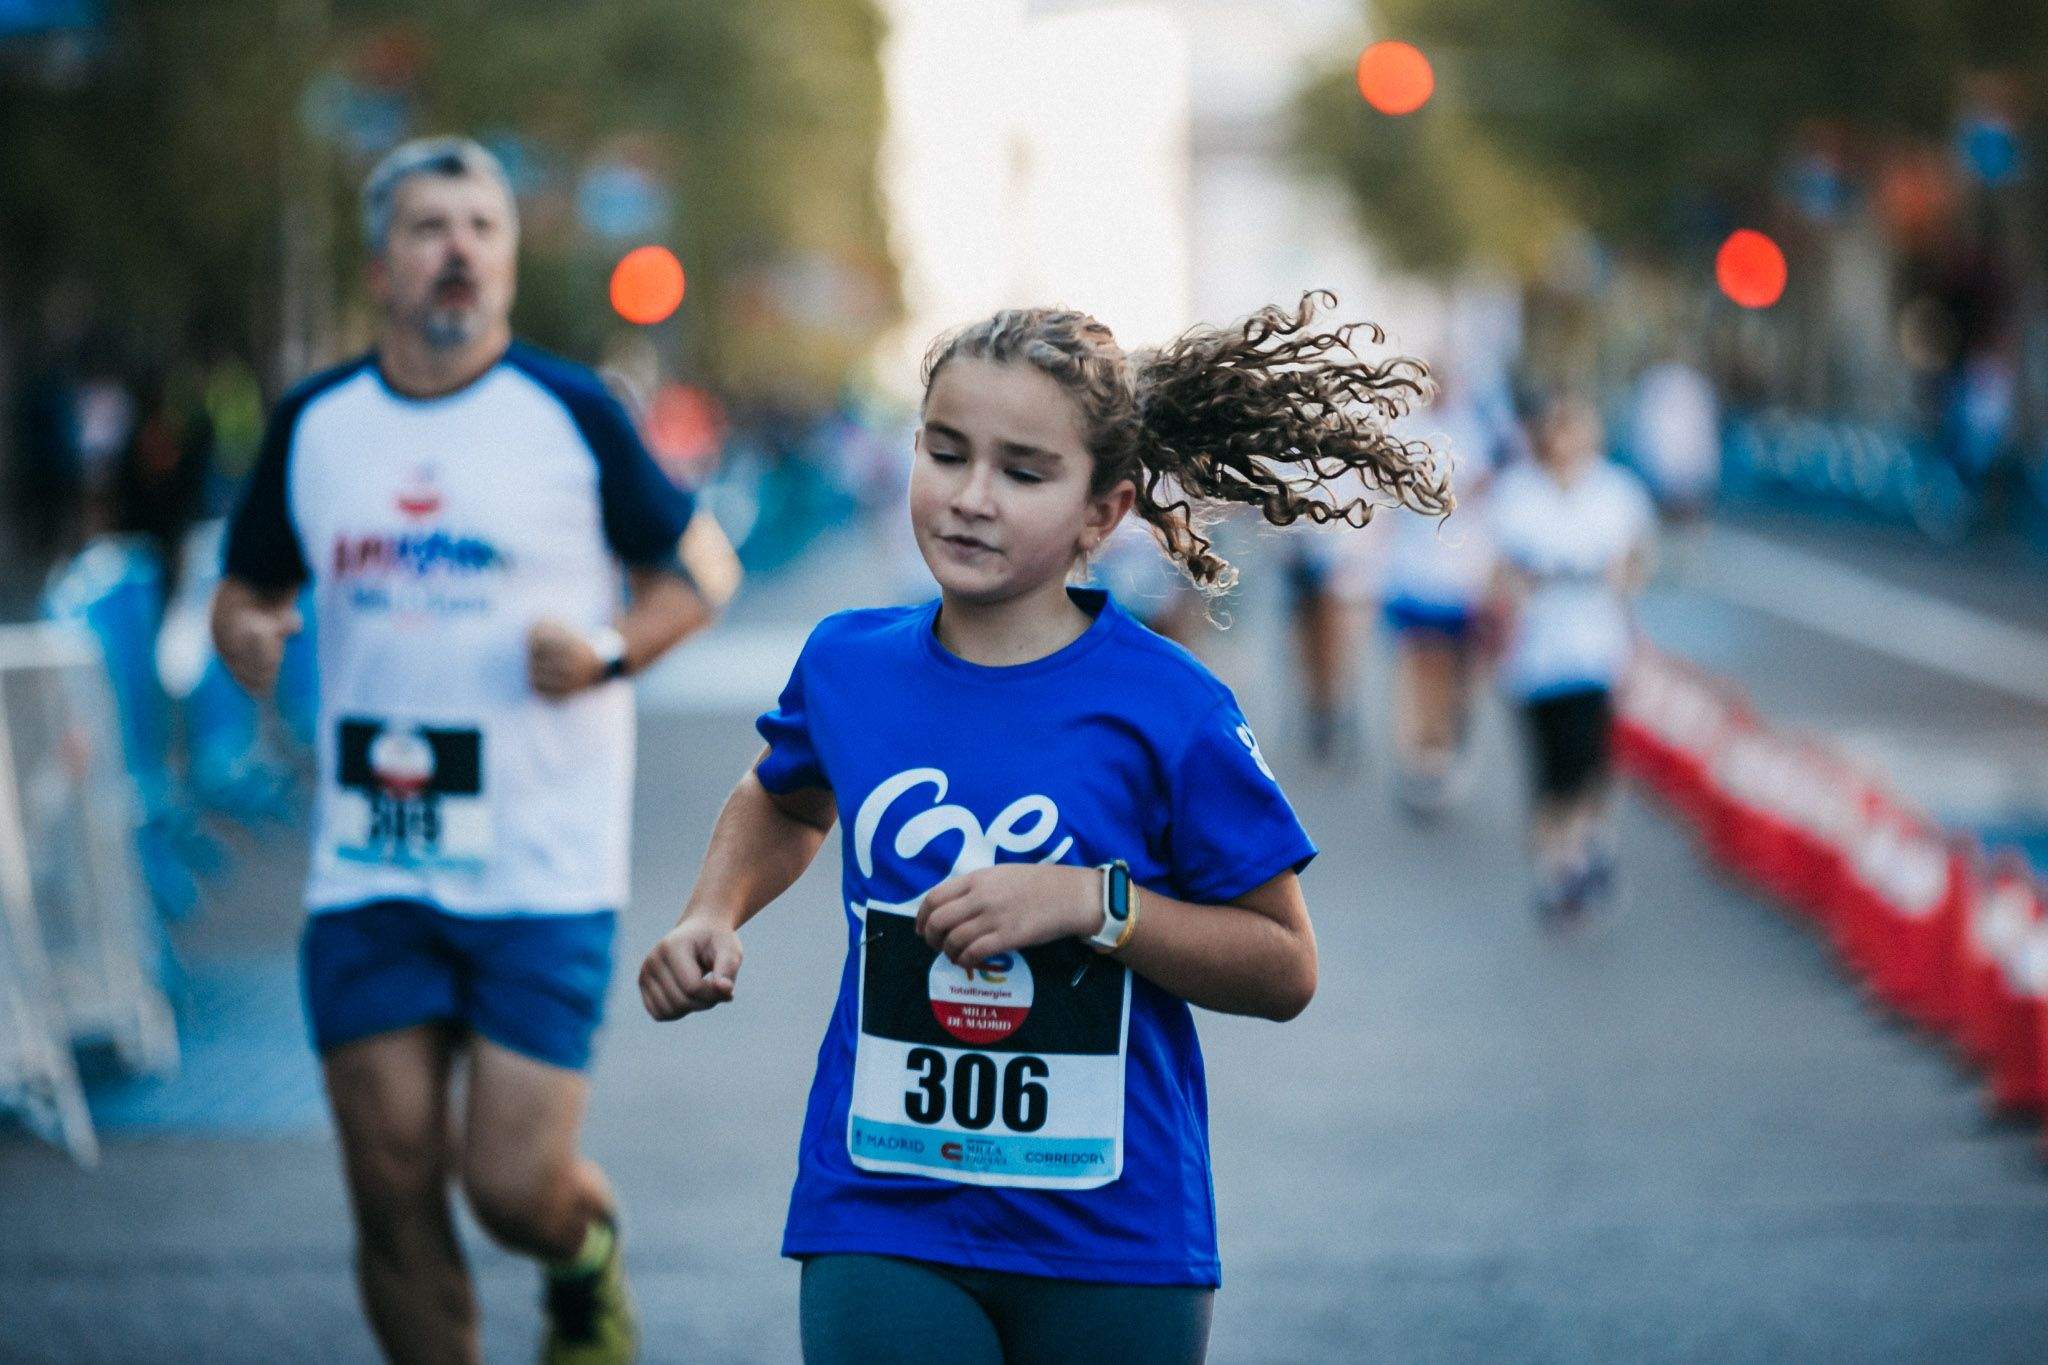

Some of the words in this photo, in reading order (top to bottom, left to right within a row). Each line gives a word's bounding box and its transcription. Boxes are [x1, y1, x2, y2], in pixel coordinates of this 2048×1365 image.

[949, 986, 1012, 999] TotalEnergies
[962, 1007, 998, 1018] MILLA
[946, 1016, 960, 1027] DE
[965, 1018, 1012, 1030] MADRID
[904, 1047, 1050, 1132] 306
[866, 1136, 925, 1153] MADRID
